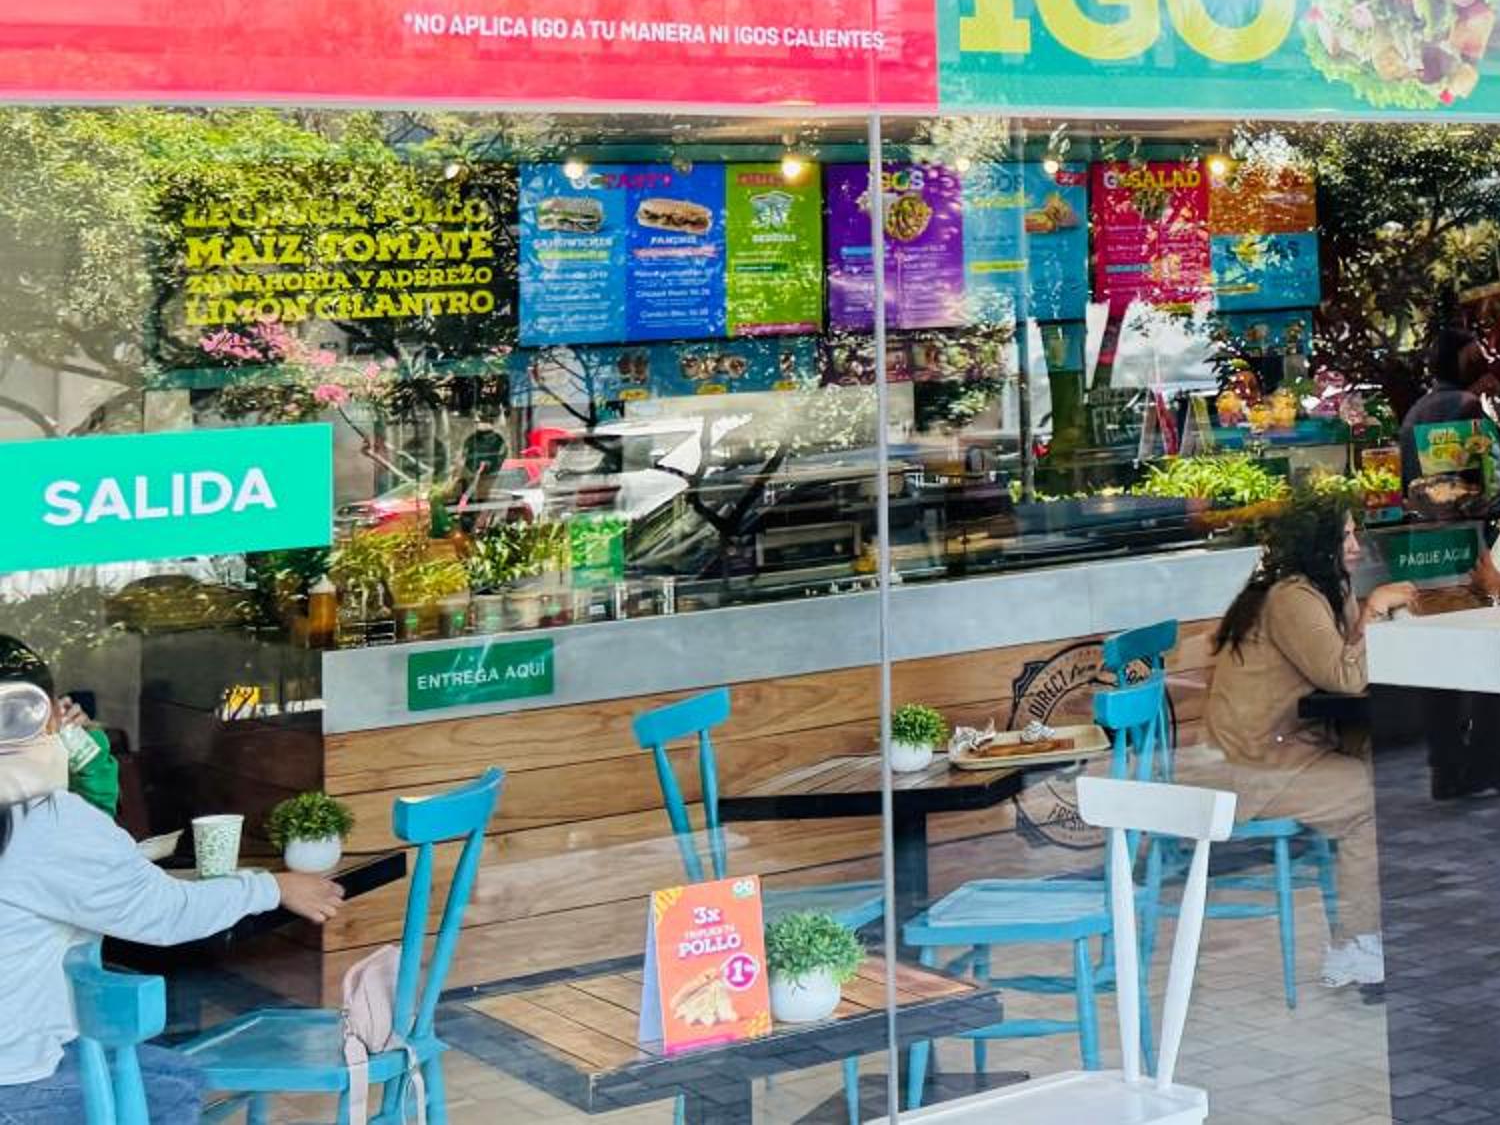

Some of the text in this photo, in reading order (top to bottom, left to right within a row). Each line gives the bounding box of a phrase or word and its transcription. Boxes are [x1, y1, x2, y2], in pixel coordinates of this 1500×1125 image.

[449, 15, 529, 39] APLICA
[532, 19, 568, 40] IGO
[571, 21, 587, 41] A
[590, 20, 616, 41] TU
[620, 21, 706, 45] MANERA
[709, 27, 731, 45] NI
[735, 26, 782, 48] IGOS
[784, 27, 886, 51] CALIENTES
[868, 171, 925, 191] GOS
[317, 230, 494, 262] TOMATE
[185, 269, 352, 294] ZANAHORIA
[356, 270, 376, 288] Y
[185, 289, 496, 326] LIMÓN CILANTRO
[43, 467, 277, 525] SALIDA
[416, 655, 545, 690] ENTREGA AQUÍ
[1028, 670, 1067, 719] DIRECT
[679, 933, 741, 959] POLLO
